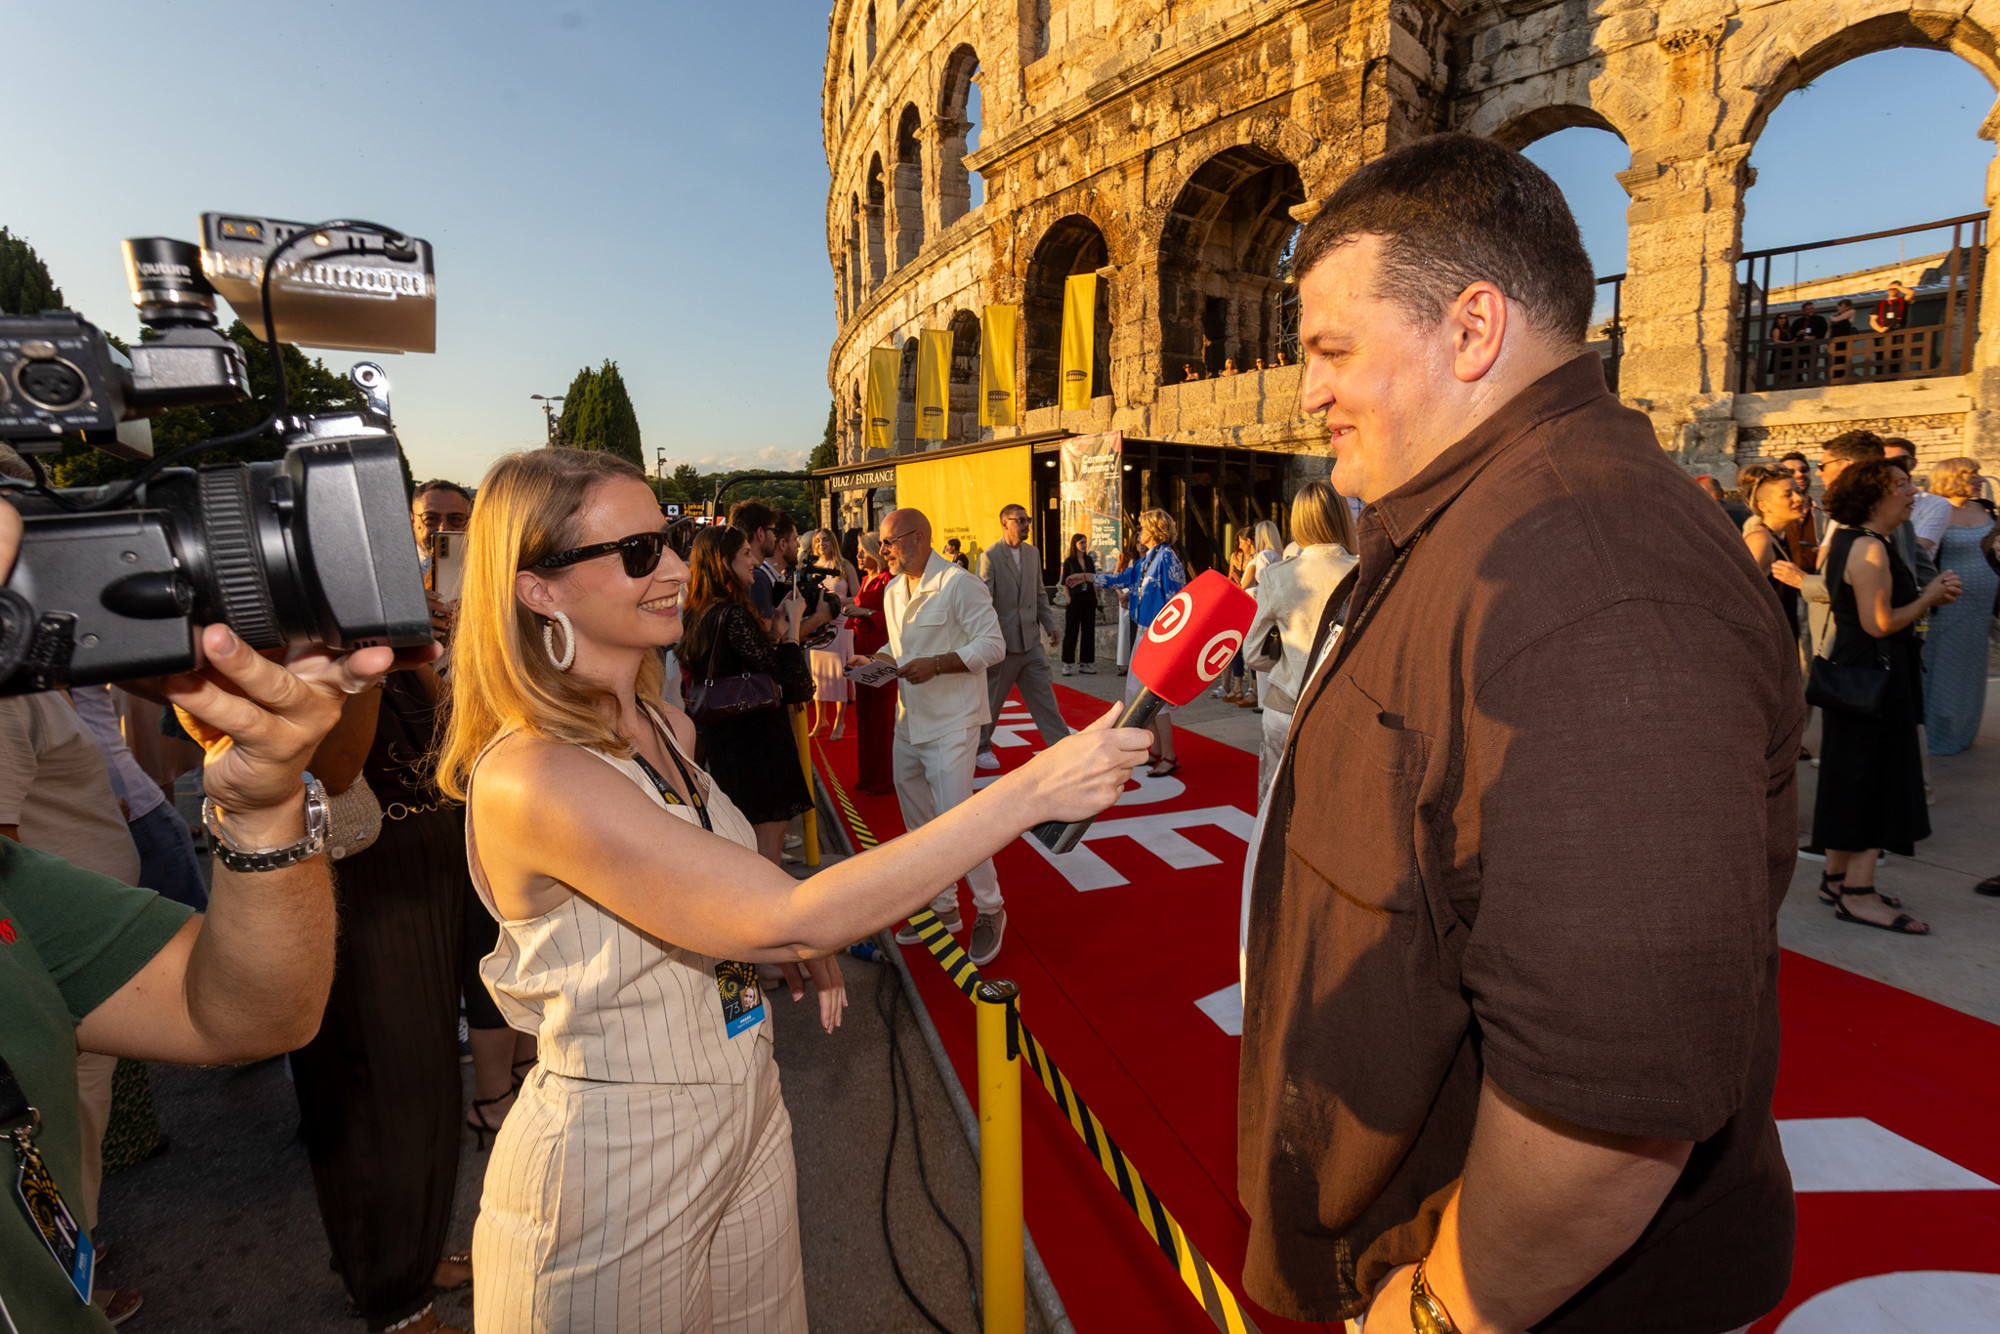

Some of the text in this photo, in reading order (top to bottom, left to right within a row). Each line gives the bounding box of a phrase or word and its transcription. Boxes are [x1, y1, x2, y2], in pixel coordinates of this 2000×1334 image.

[1082, 453, 1114, 464] Carmina
[1082, 464, 1109, 473] Burana
[832, 476, 850, 488] ULAZ
[855, 470, 895, 485] ENTRANCE
